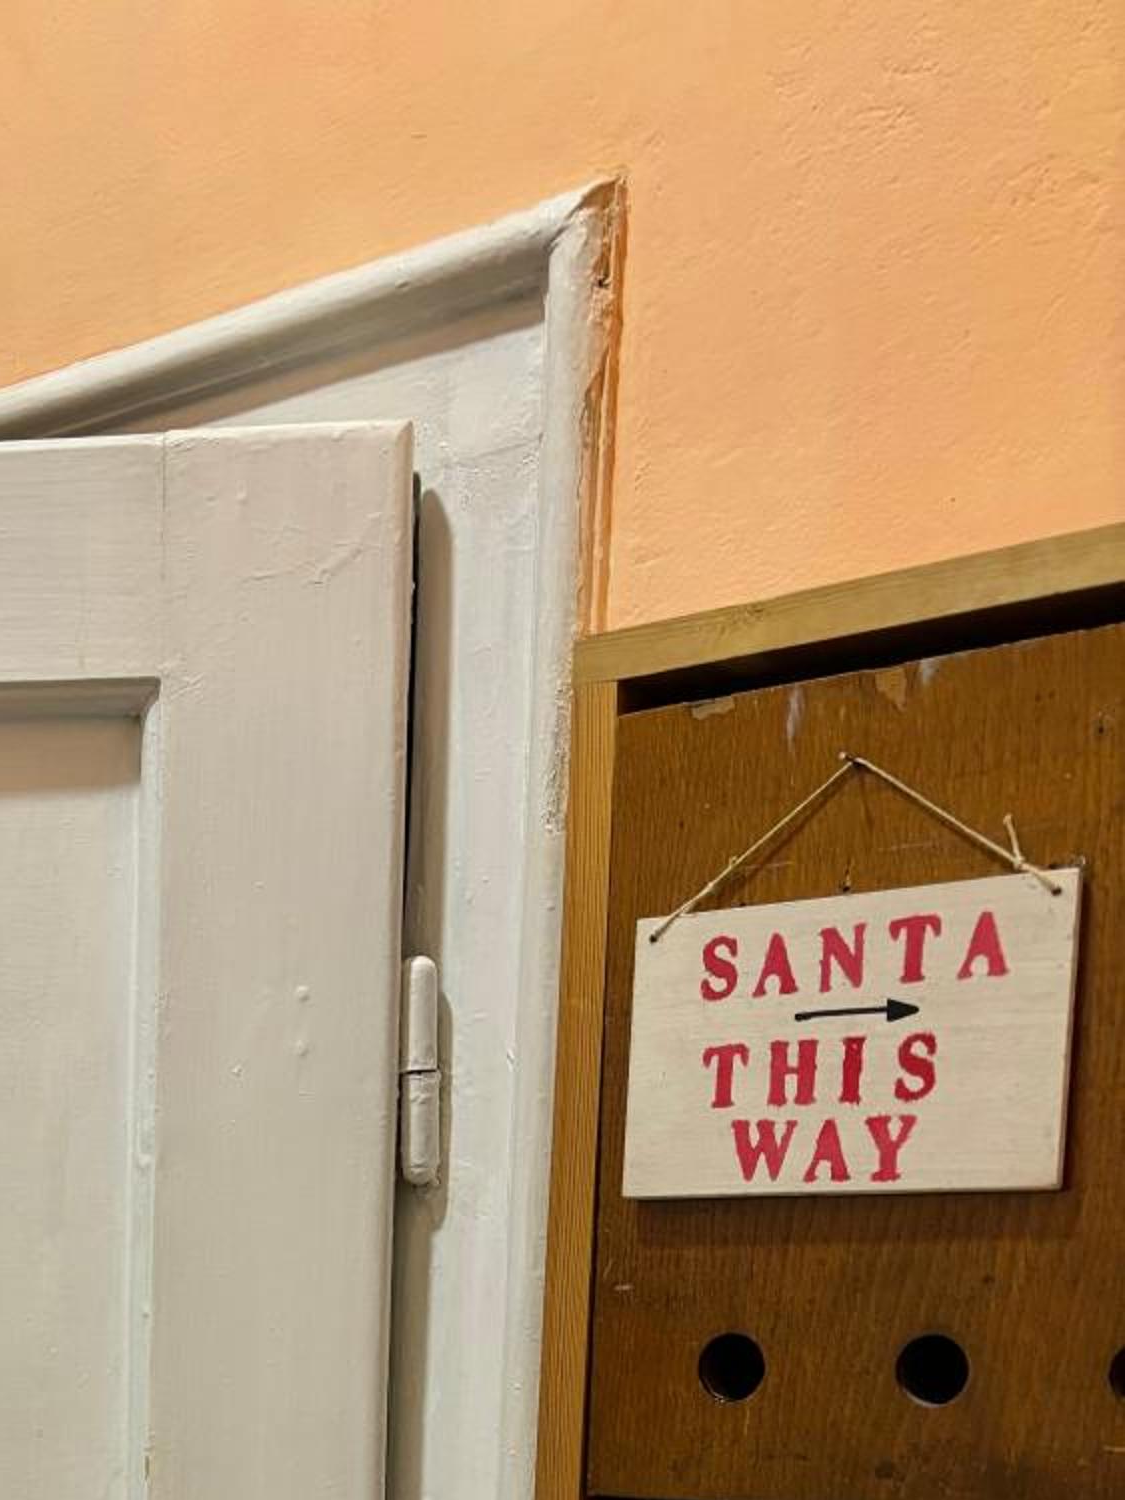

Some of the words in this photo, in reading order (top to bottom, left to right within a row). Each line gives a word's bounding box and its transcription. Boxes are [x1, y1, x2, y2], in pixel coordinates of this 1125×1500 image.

[700, 911, 1009, 1001] SANTA
[702, 1032, 938, 1109] THIS
[731, 1114, 917, 1184] WAY
